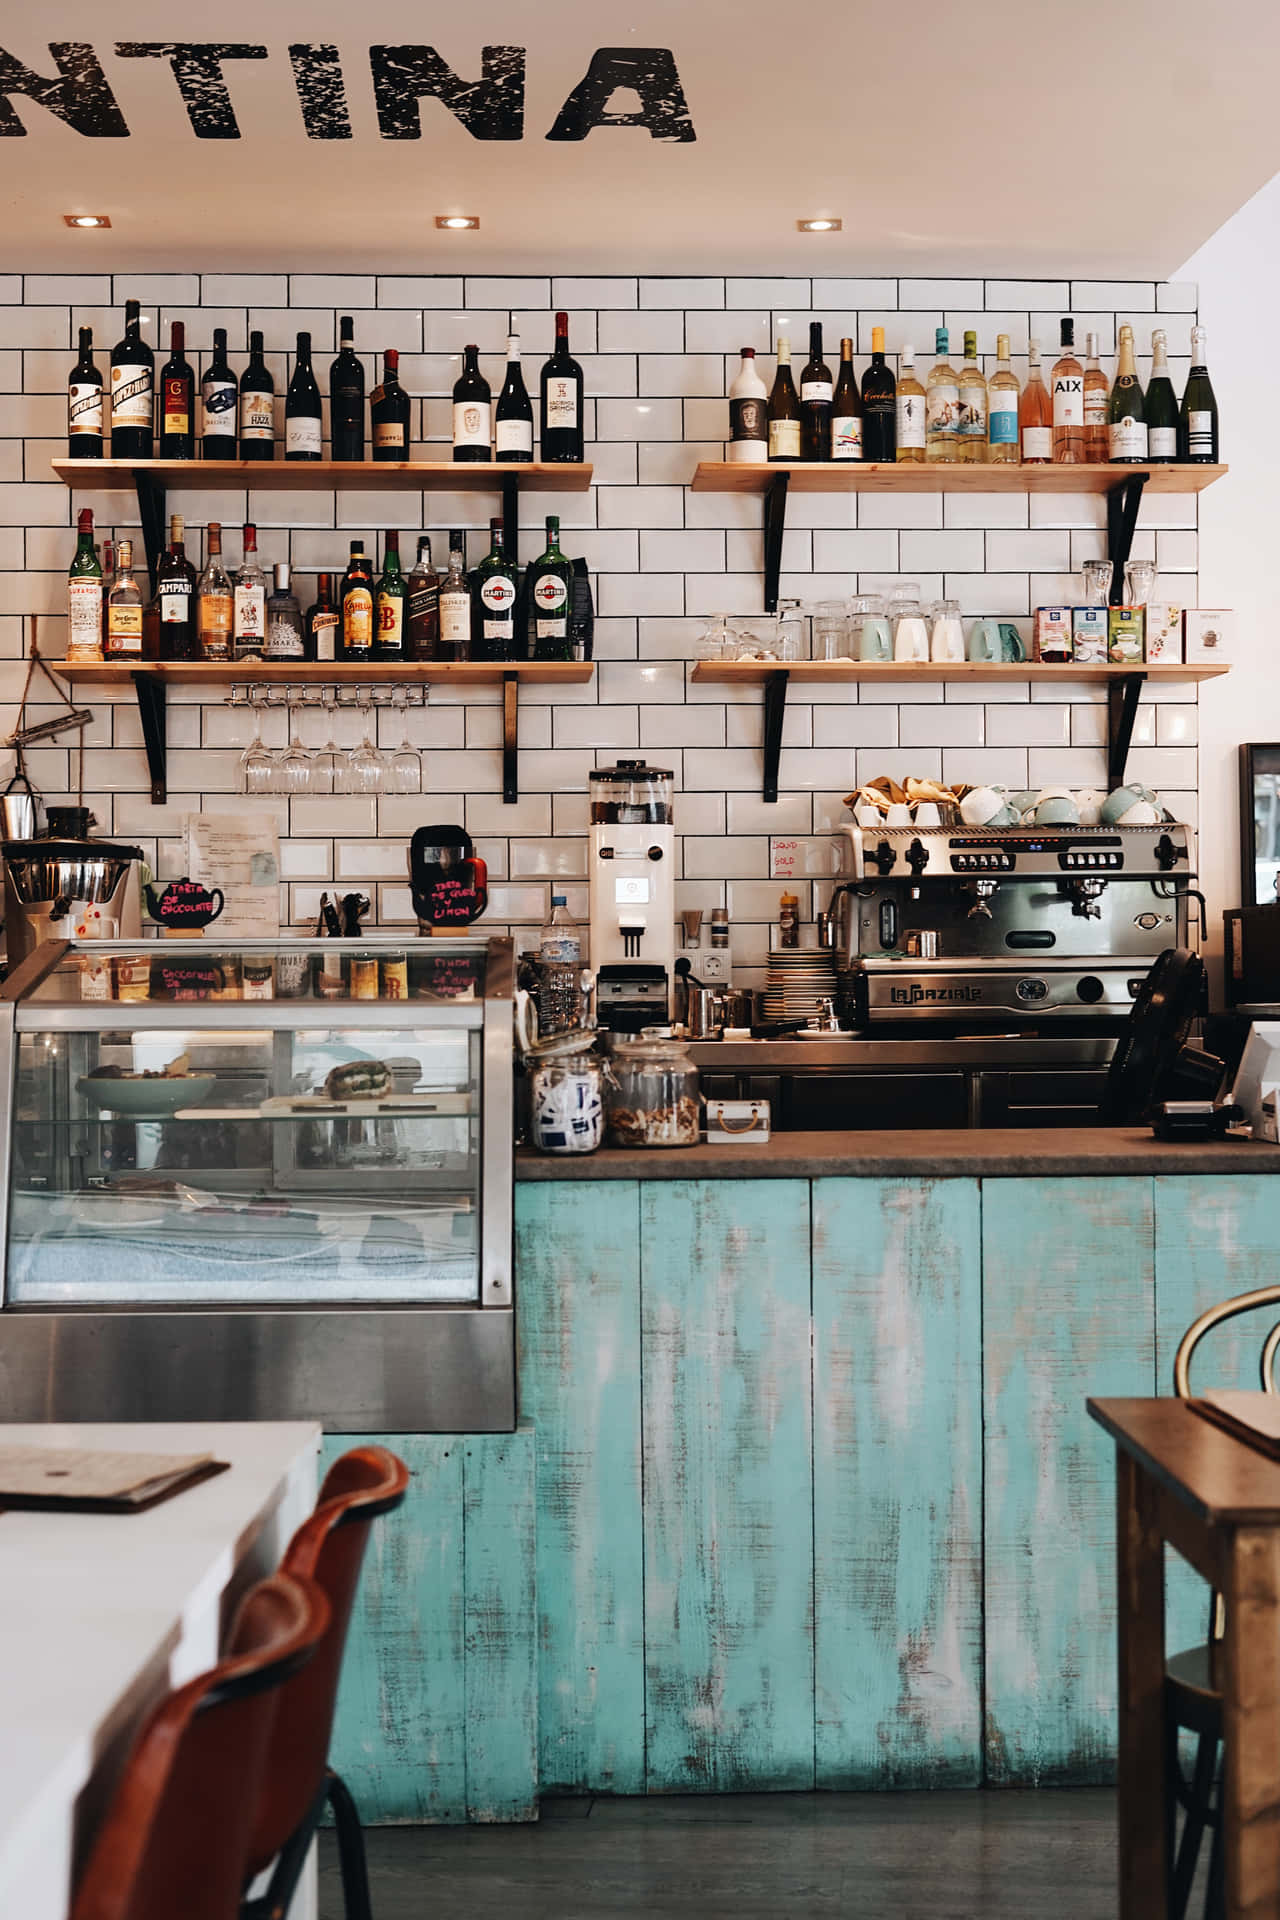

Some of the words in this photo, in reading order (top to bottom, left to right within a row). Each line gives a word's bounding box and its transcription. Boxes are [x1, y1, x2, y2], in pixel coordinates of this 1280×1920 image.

[0, 42, 697, 142] NTINA
[1055, 380, 1081, 393] AIX
[159, 583, 192, 594] CAMPARI
[536, 588, 564, 596] MARTINI
[171, 884, 203, 895] TARTA
[161, 902, 213, 915] CHOCOLATE
